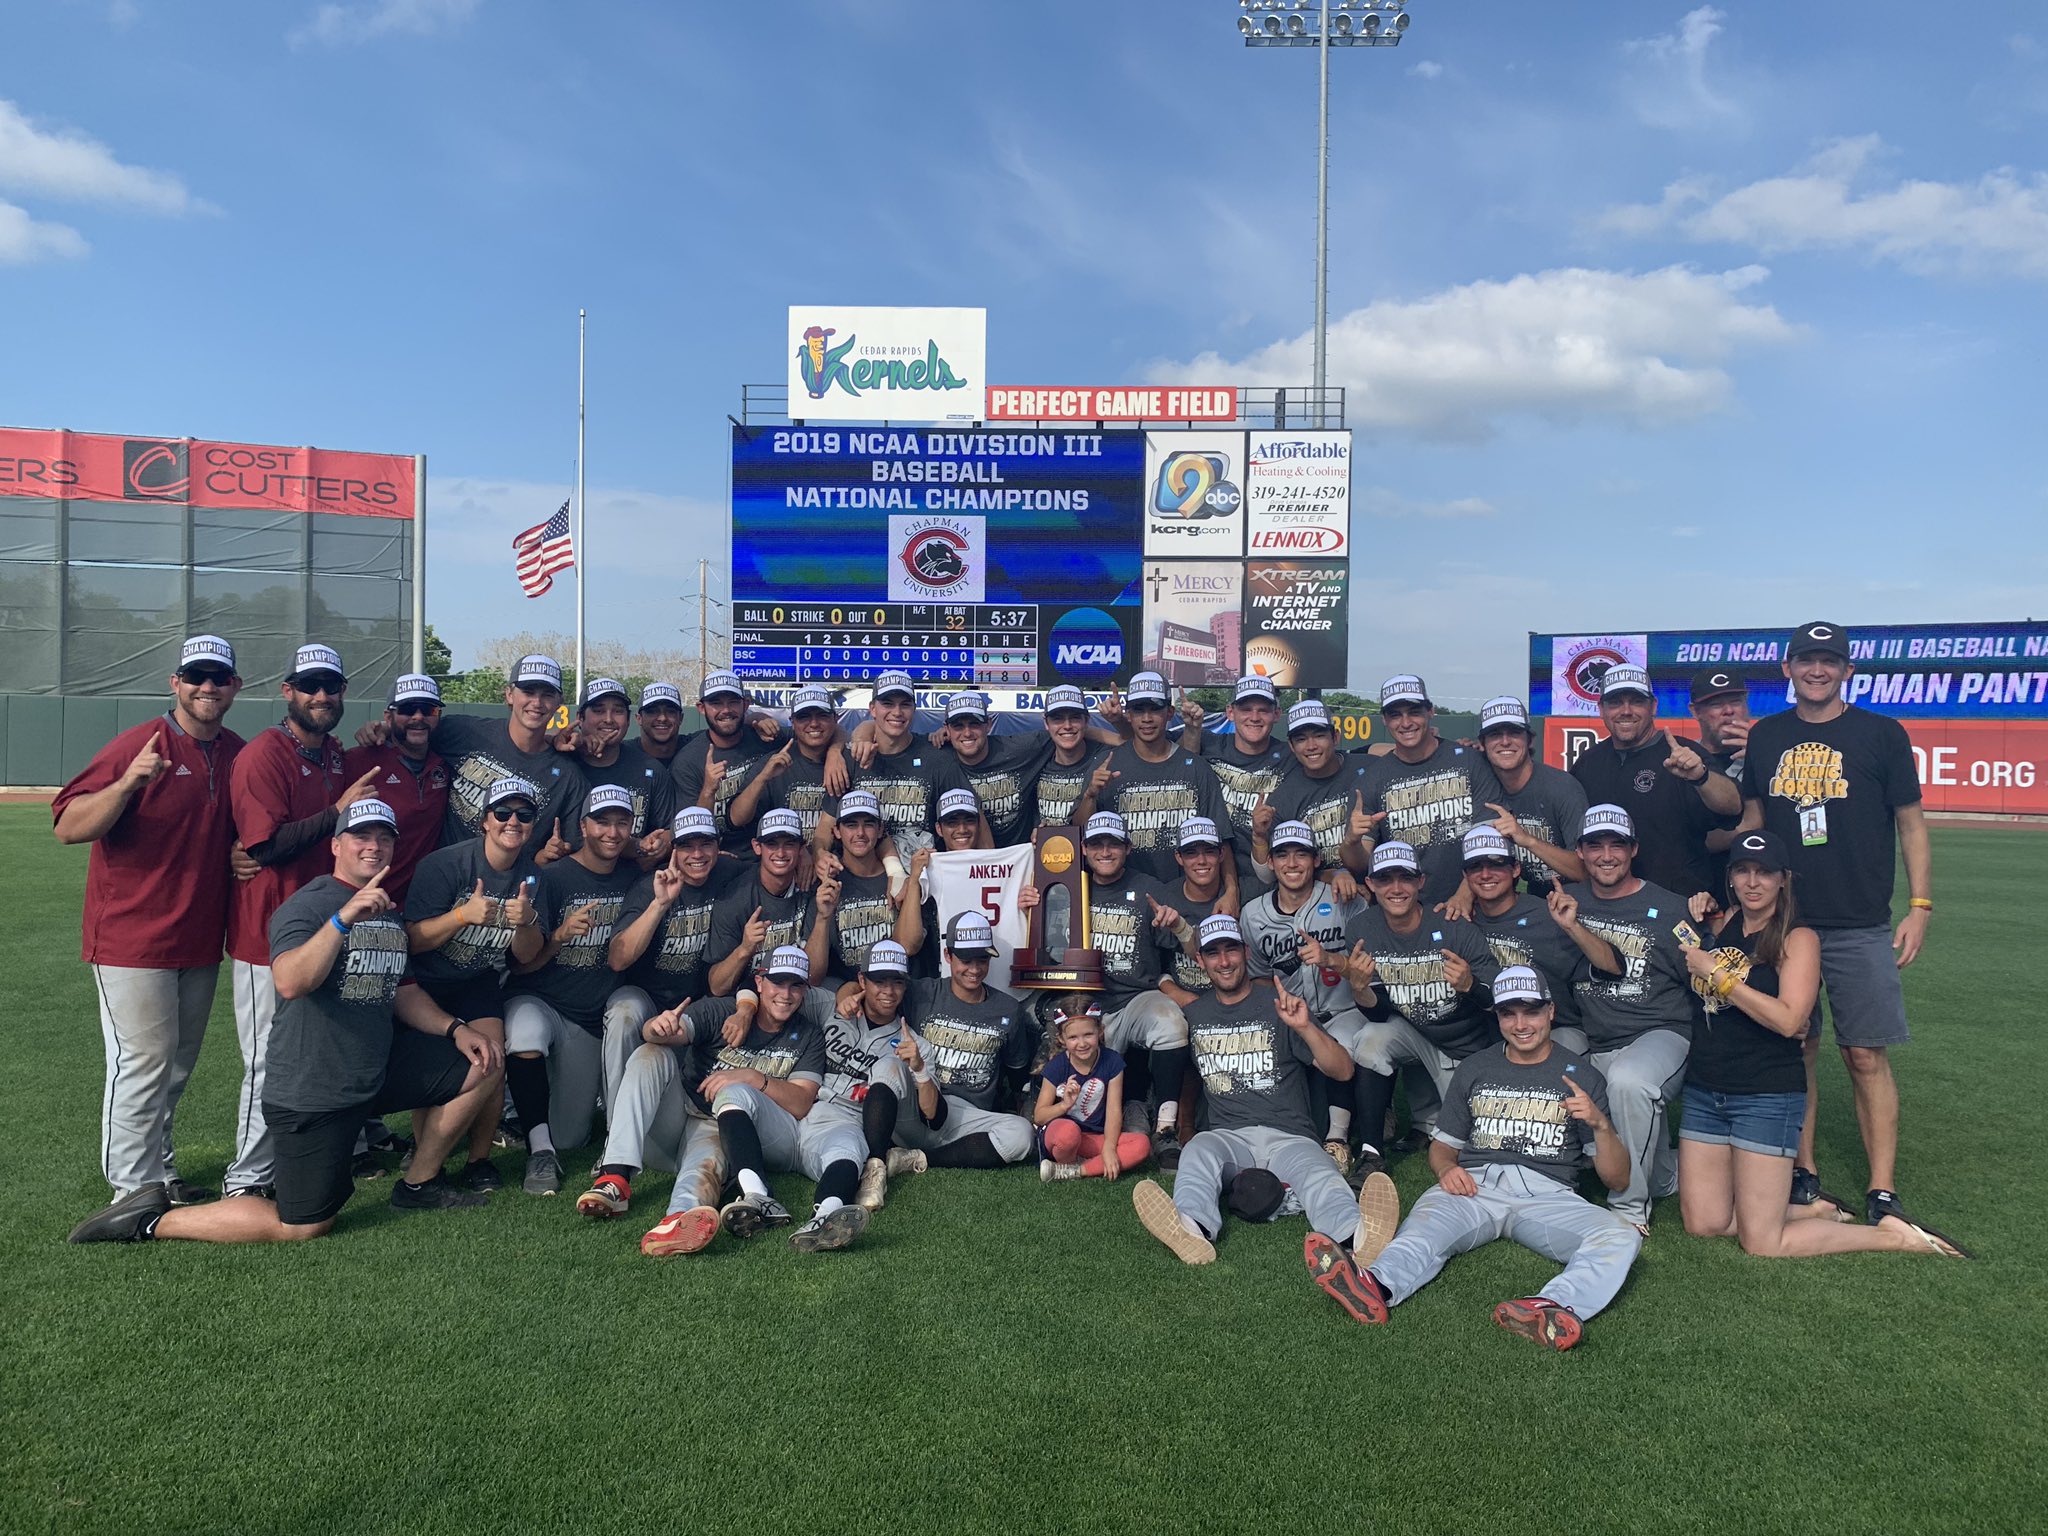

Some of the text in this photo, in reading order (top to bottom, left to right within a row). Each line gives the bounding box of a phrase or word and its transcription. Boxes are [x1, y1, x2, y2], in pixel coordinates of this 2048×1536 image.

[860, 346, 922, 355] CEDAR RAPIDS
[796, 326, 968, 399] Kernels
[992, 391, 1230, 416] PERFECT GAME FIELD
[774, 432, 1102, 456] 2019 NCAA DIVISION III
[1254, 442, 1347, 459] Affordable
[206, 449, 295, 470] COST
[872, 461, 1004, 483] BASEBALL
[1253, 467, 1347, 478] Heating & Cooling
[206, 471, 398, 504] CUTTERS
[1167, 454, 1215, 519] 9
[1252, 486, 1346, 500] 319-241-4520
[786, 486, 1089, 511] NATIONAL CHAMPIONS
[1205, 489, 1240, 505] abc
[1272, 515, 1325, 523] DEALER
[904, 517, 971, 538] CHAPMAN
[1151, 524, 1230, 536] kcrg.com
[1252, 531, 1326, 548] LENNOX
[1173, 574, 1234, 590] MERCY
[1250, 569, 1346, 585] XTREAM
[903, 576, 970, 598] UNIVERSITY
[1296, 582, 1320, 593] TV
[1252, 596, 1341, 607] INTERNET
[744, 608, 885, 625] BALL 0 STRIKE 0 OUT 0
[913, 606, 926, 615] H/E
[944, 607, 966, 615] AT BAT
[1272, 608, 1320, 619] GAME
[945, 616, 965, 630] 32
[990, 611, 1027, 626] 5:37
[1260, 620, 1332, 631] CHANGER
[734, 634, 1029, 646] FINAL 1 2 3 4 5 6 7 8 9 R H E
[1808, 626, 1833, 640] C
[183, 639, 232, 659] CHAMPIONS
[1173, 645, 1216, 660] EMERGENCY
[1567, 638, 1632, 656] CHAPMAN
[1676, 643, 1723, 662] 2019
[1727, 642, 1777, 662] NCAA
[1880, 639, 1904, 659] III
[1908, 637, 2019, 658] BASEBALL
[298, 651, 342, 668] CHAMPIONS
[734, 650, 1030, 664] BSC 0 0 0 0 0 0 0 0 0 0 6 4
[1056, 645, 1122, 665] NCAA
[521, 663, 560, 679] CHAMPIONS
[734, 668, 1030, 682] CHAPMAN 0 0 0 0 2 8 X 11 8 0
[705, 677, 741, 689] CHAMPIONS
[878, 677, 913, 688] CHAMPIONS
[1605, 672, 1647, 685] CHAMPIONS
[1710, 673, 1730, 687] C
[397, 681, 438, 694] CHAMPIONS
[589, 681, 625, 694] CHAMPIONS
[1129, 682, 1163, 692] CHAMPIONS
[1237, 681, 1272, 691] CHAMPIONS
[1383, 682, 1420, 698] CHAMPIONS
[643, 688, 679, 700] CHAMPIONS
[795, 692, 830, 703] CHAMPIONS
[1049, 692, 1082, 703] CHAMPIONS
[950, 698, 983, 710] CHAMPIONS
[1288, 708, 1324, 723] CHAMPIONS
[1482, 705, 1522, 718] CHAMPIONS
[1333, 716, 1371, 740] 390
[491, 784, 533, 796] CHAMPIONS
[1386, 776, 1469, 812] NATIONAL
[1770, 778, 1848, 798] FOREVER
[591, 792, 631, 804] CHAMPIONS
[842, 797, 878, 808] CHAMPIONS
[941, 796, 975, 808] CHAMPIONS
[1119, 789, 1196, 811] NATIONAL
[350, 806, 395, 822] CHAMPIONS
[1121, 809, 1197, 830] CHAMPIONS
[1389, 796, 1473, 830] CHAMPIONS
[1585, 812, 1628, 827] CHAMPIONS
[675, 816, 714, 829] CHAMPIONS
[763, 816, 799, 829] CHAMPIONS
[1087, 818, 1123, 830] CHAMPIONS
[1181, 824, 1217, 836] CHAMPIONS
[1273, 827, 1311, 840] CHAMPIONS
[1464, 837, 1504, 851] CHAMPIONS
[1742, 835, 1765, 850] C
[1043, 853, 1072, 864] NCAA
[1373, 849, 1414, 864] CHAMPIONS
[969, 864, 1013, 879] ANKENY
[981, 887, 1001, 926] 5
[957, 930, 991, 941] CHAMPIONS
[1200, 922, 1238, 936] CHAMPIONS
[772, 955, 808, 969] CHAMPIONS
[871, 951, 907, 964] CHAMPIONS
[1047, 972, 1077, 980] CHAMPION
[1494, 978, 1537, 993] CHAMPIONS
[1194, 1030, 1272, 1056] NATIONAL
[1197, 1051, 1273, 1077] CHAMPIONS
[1472, 1095, 1567, 1124] NATIONAL
[1475, 1117, 1566, 1147] CHAMPIONS
